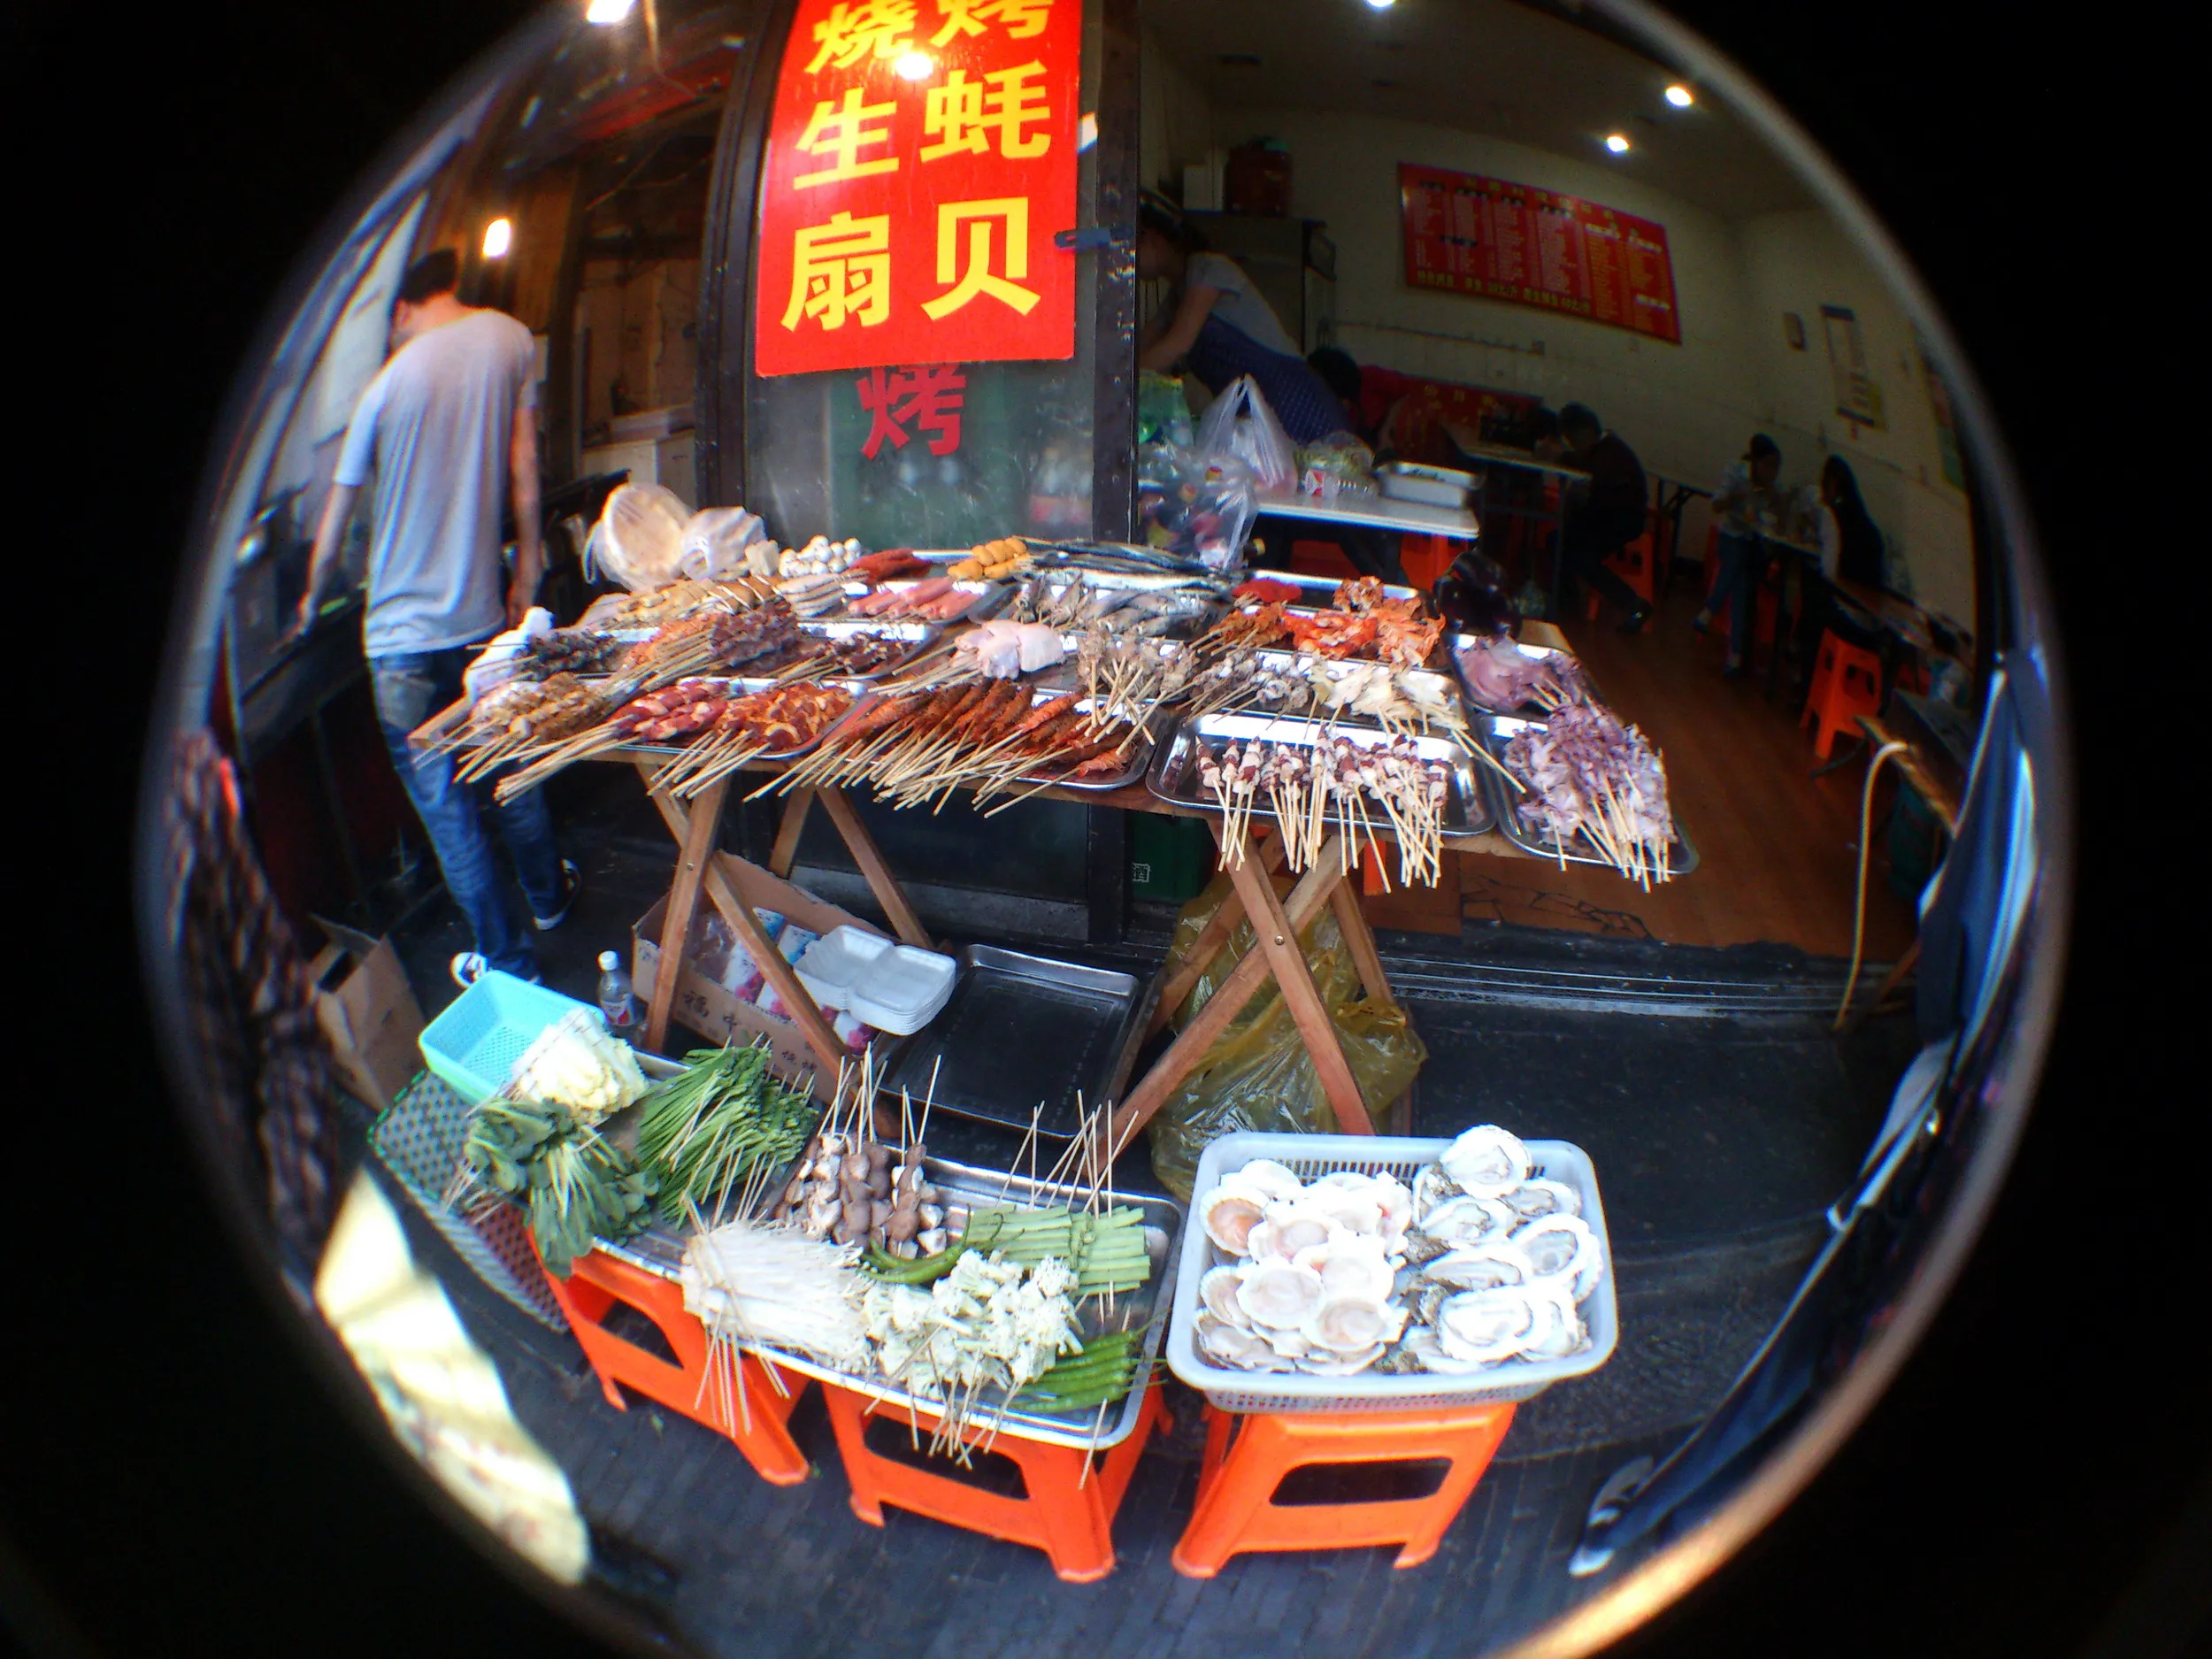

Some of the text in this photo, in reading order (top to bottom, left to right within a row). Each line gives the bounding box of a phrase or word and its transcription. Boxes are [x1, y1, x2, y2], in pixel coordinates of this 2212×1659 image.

[793, 59, 1052, 190] 生蚝
[780, 196, 1042, 333] 扇贝
[856, 362, 967, 461] 烤
